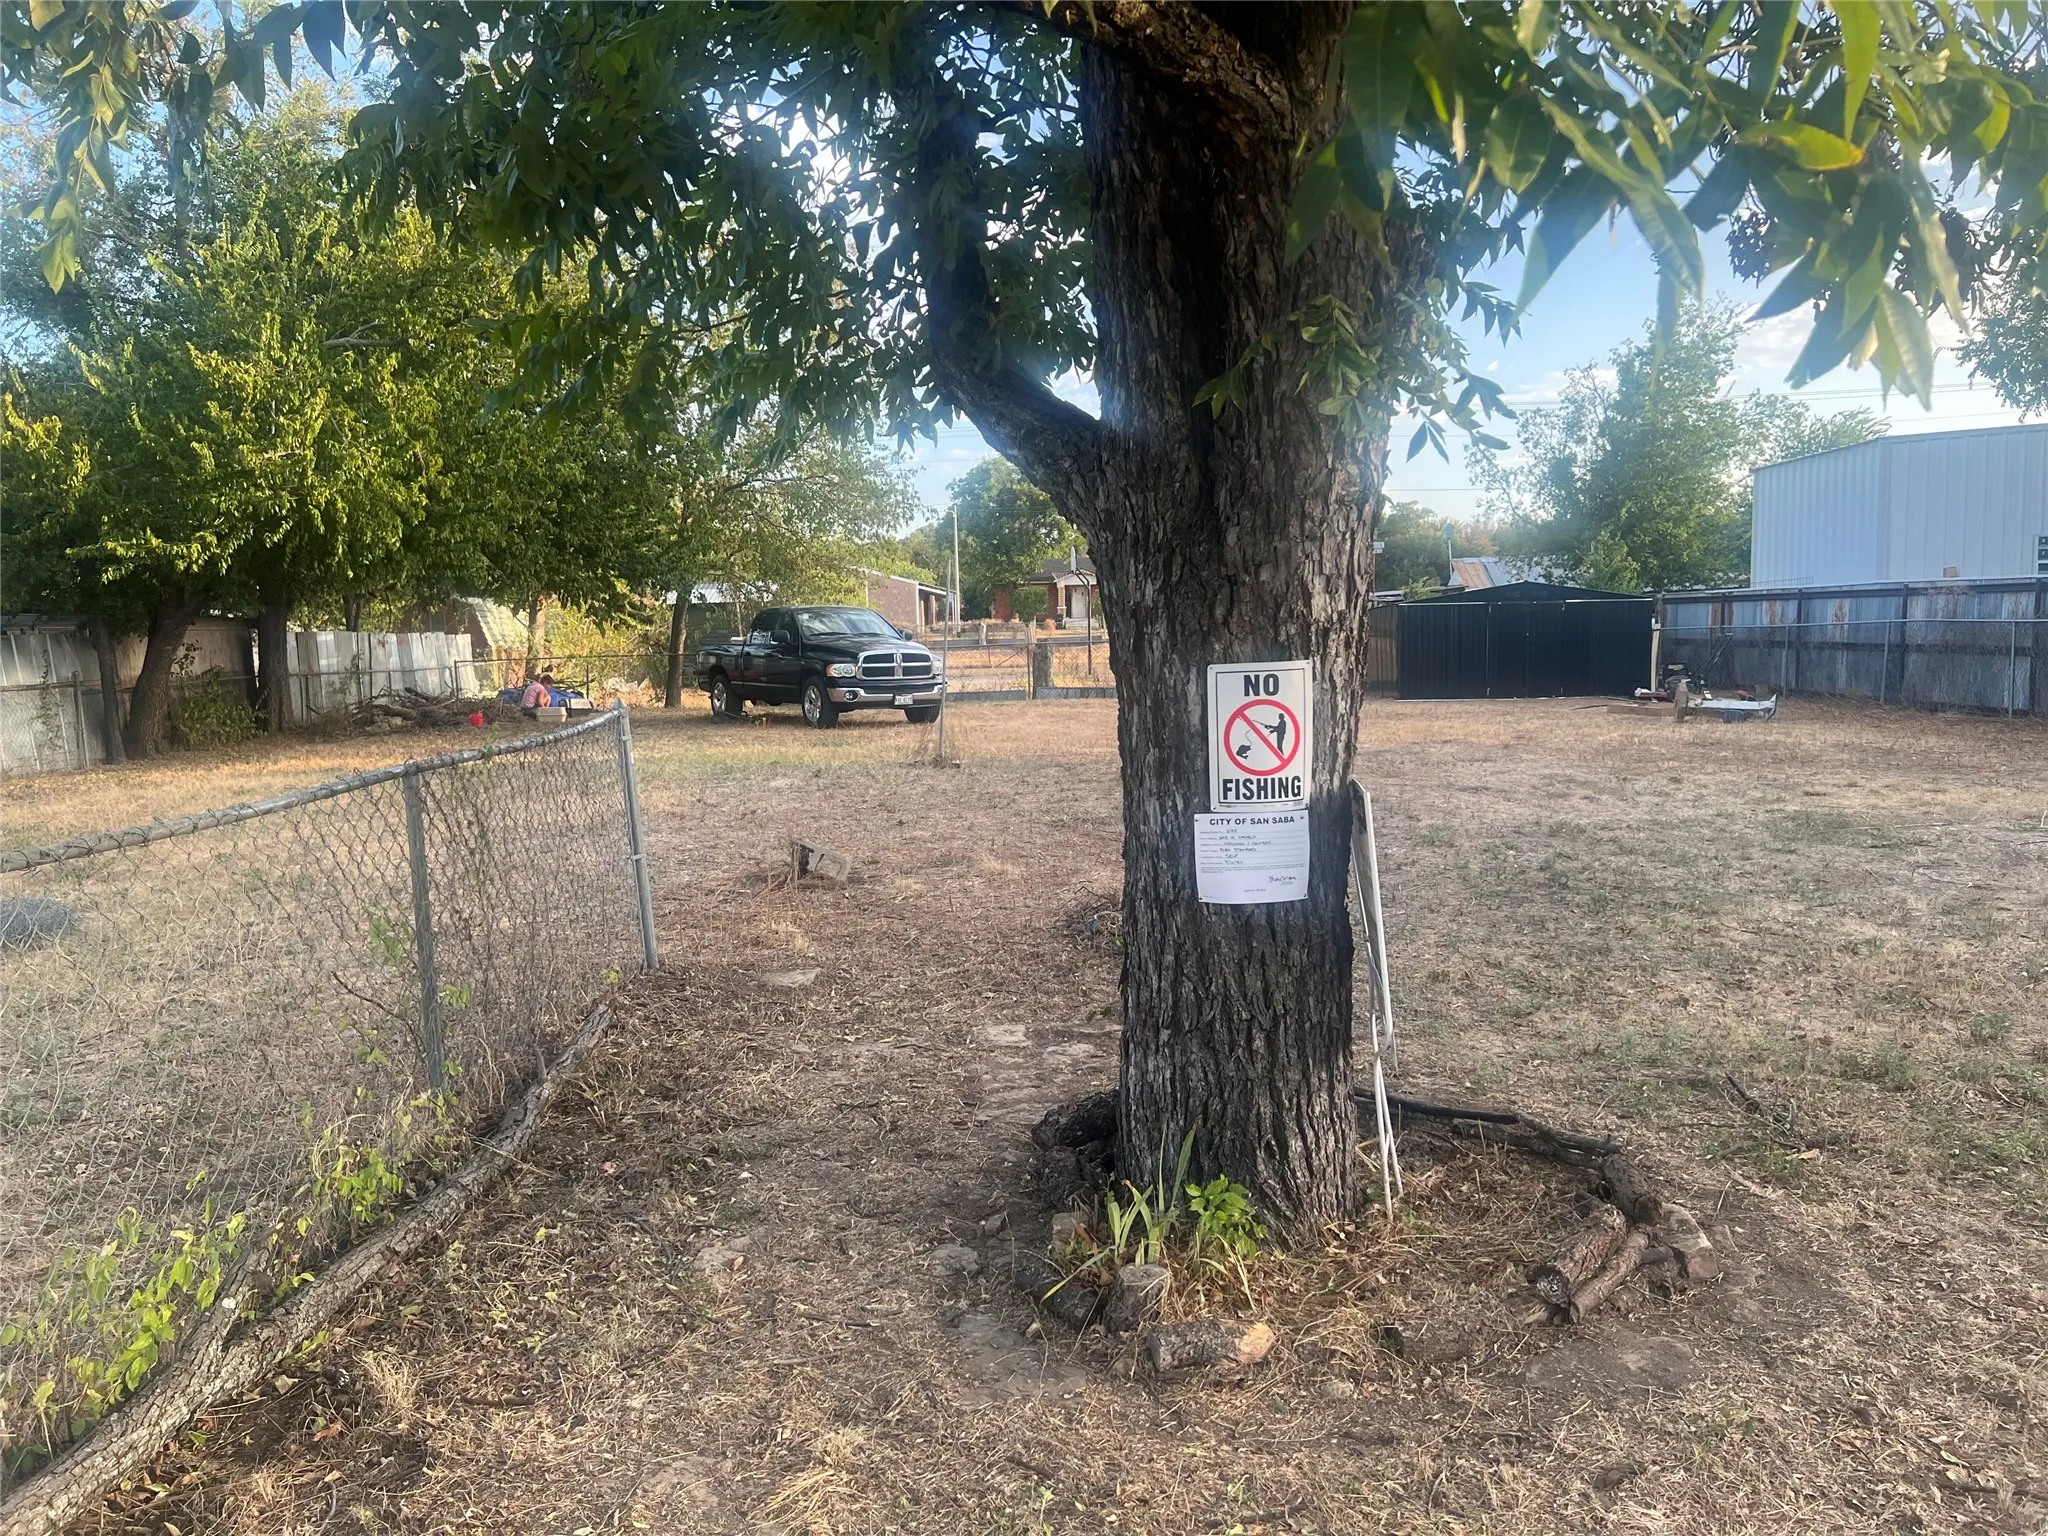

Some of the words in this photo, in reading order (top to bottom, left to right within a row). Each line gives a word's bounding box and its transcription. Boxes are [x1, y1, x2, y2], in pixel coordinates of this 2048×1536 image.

[1243, 673, 1280, 697] NO
[1222, 775, 1302, 801] FISHING
[1209, 818, 1232, 826] CITY
[1234, 817, 1247, 826] OF
[1250, 817, 1269, 825] SAN
[1272, 815, 1295, 824] SABA
